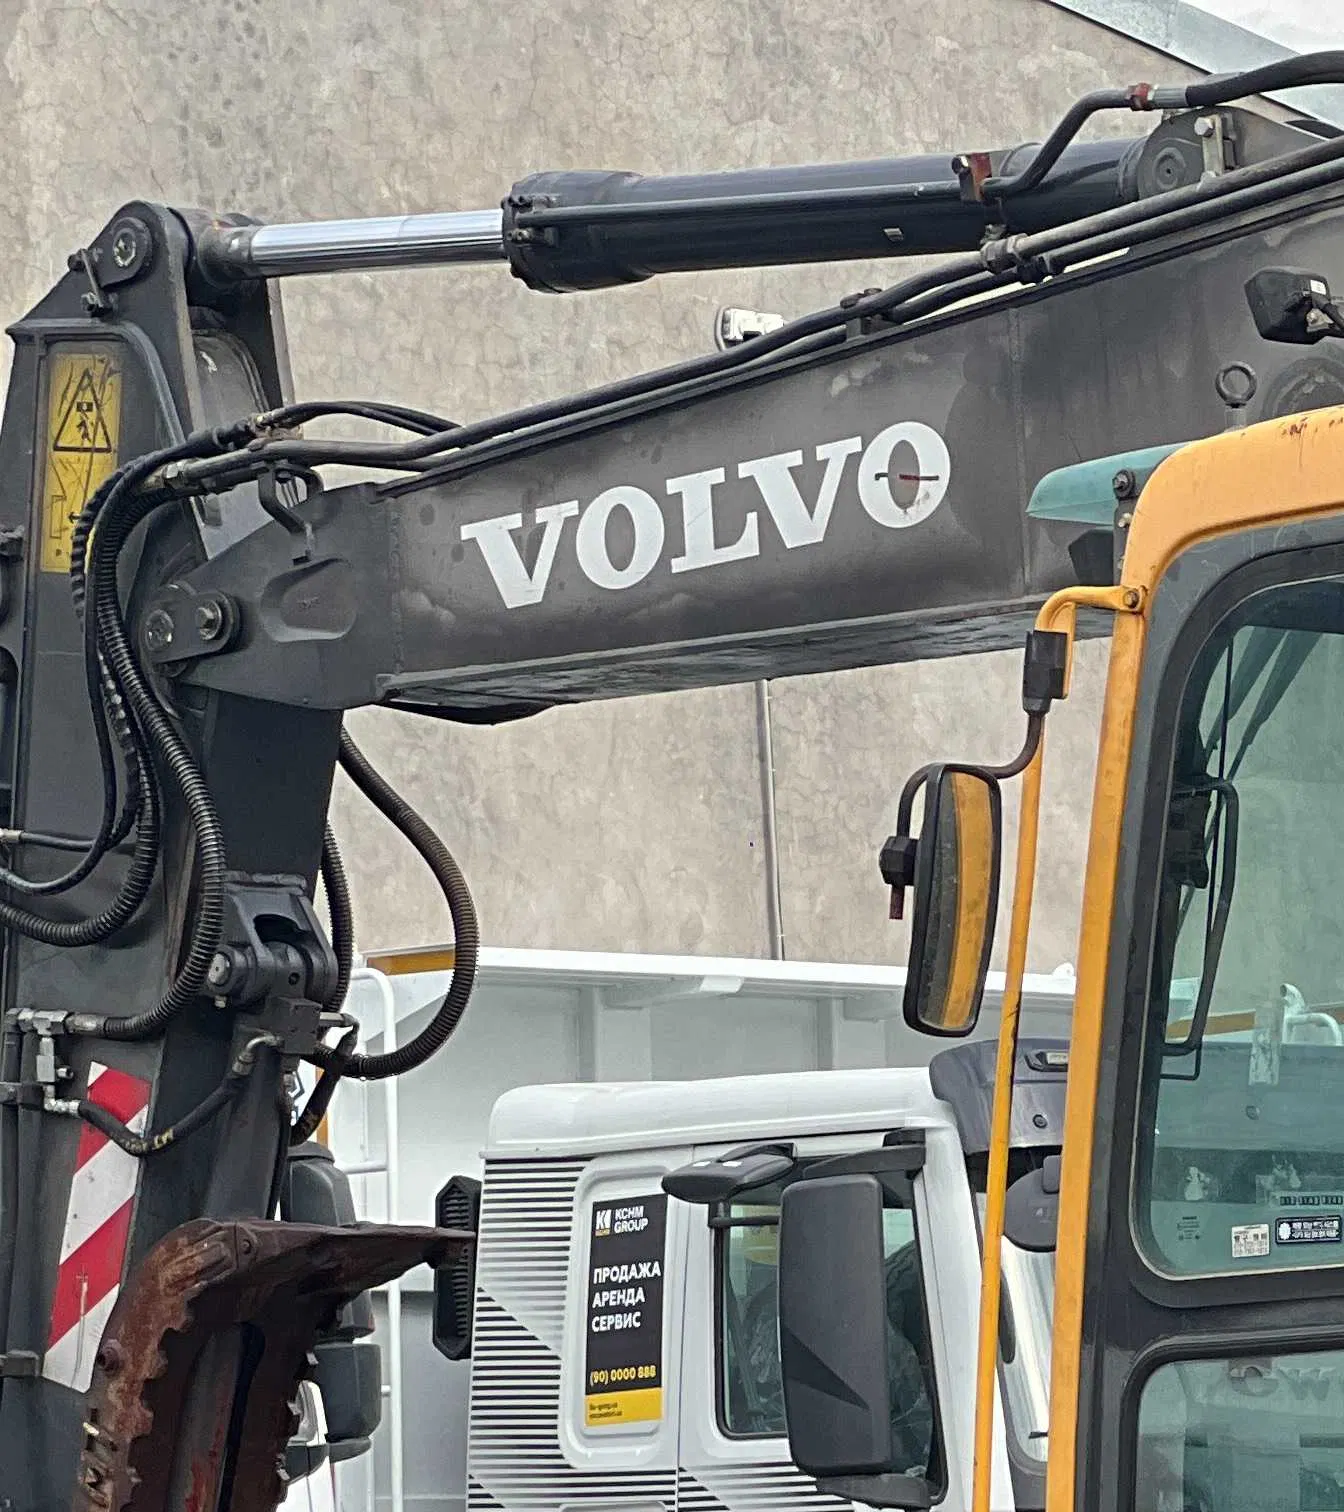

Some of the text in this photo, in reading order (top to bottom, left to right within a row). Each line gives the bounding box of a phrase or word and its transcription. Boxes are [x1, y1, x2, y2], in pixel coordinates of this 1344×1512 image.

[460, 420, 951, 609] VOLVO
[615, 1206, 644, 1220] KCHM
[614, 1218, 649, 1233] GROUP
[593, 1261, 661, 1284] ПРОДАЖА
[592, 1286, 645, 1308] АРЕНДА
[592, 1311, 641, 1333] СЕРВИС
[611, 1367, 636, 1381] 0000
